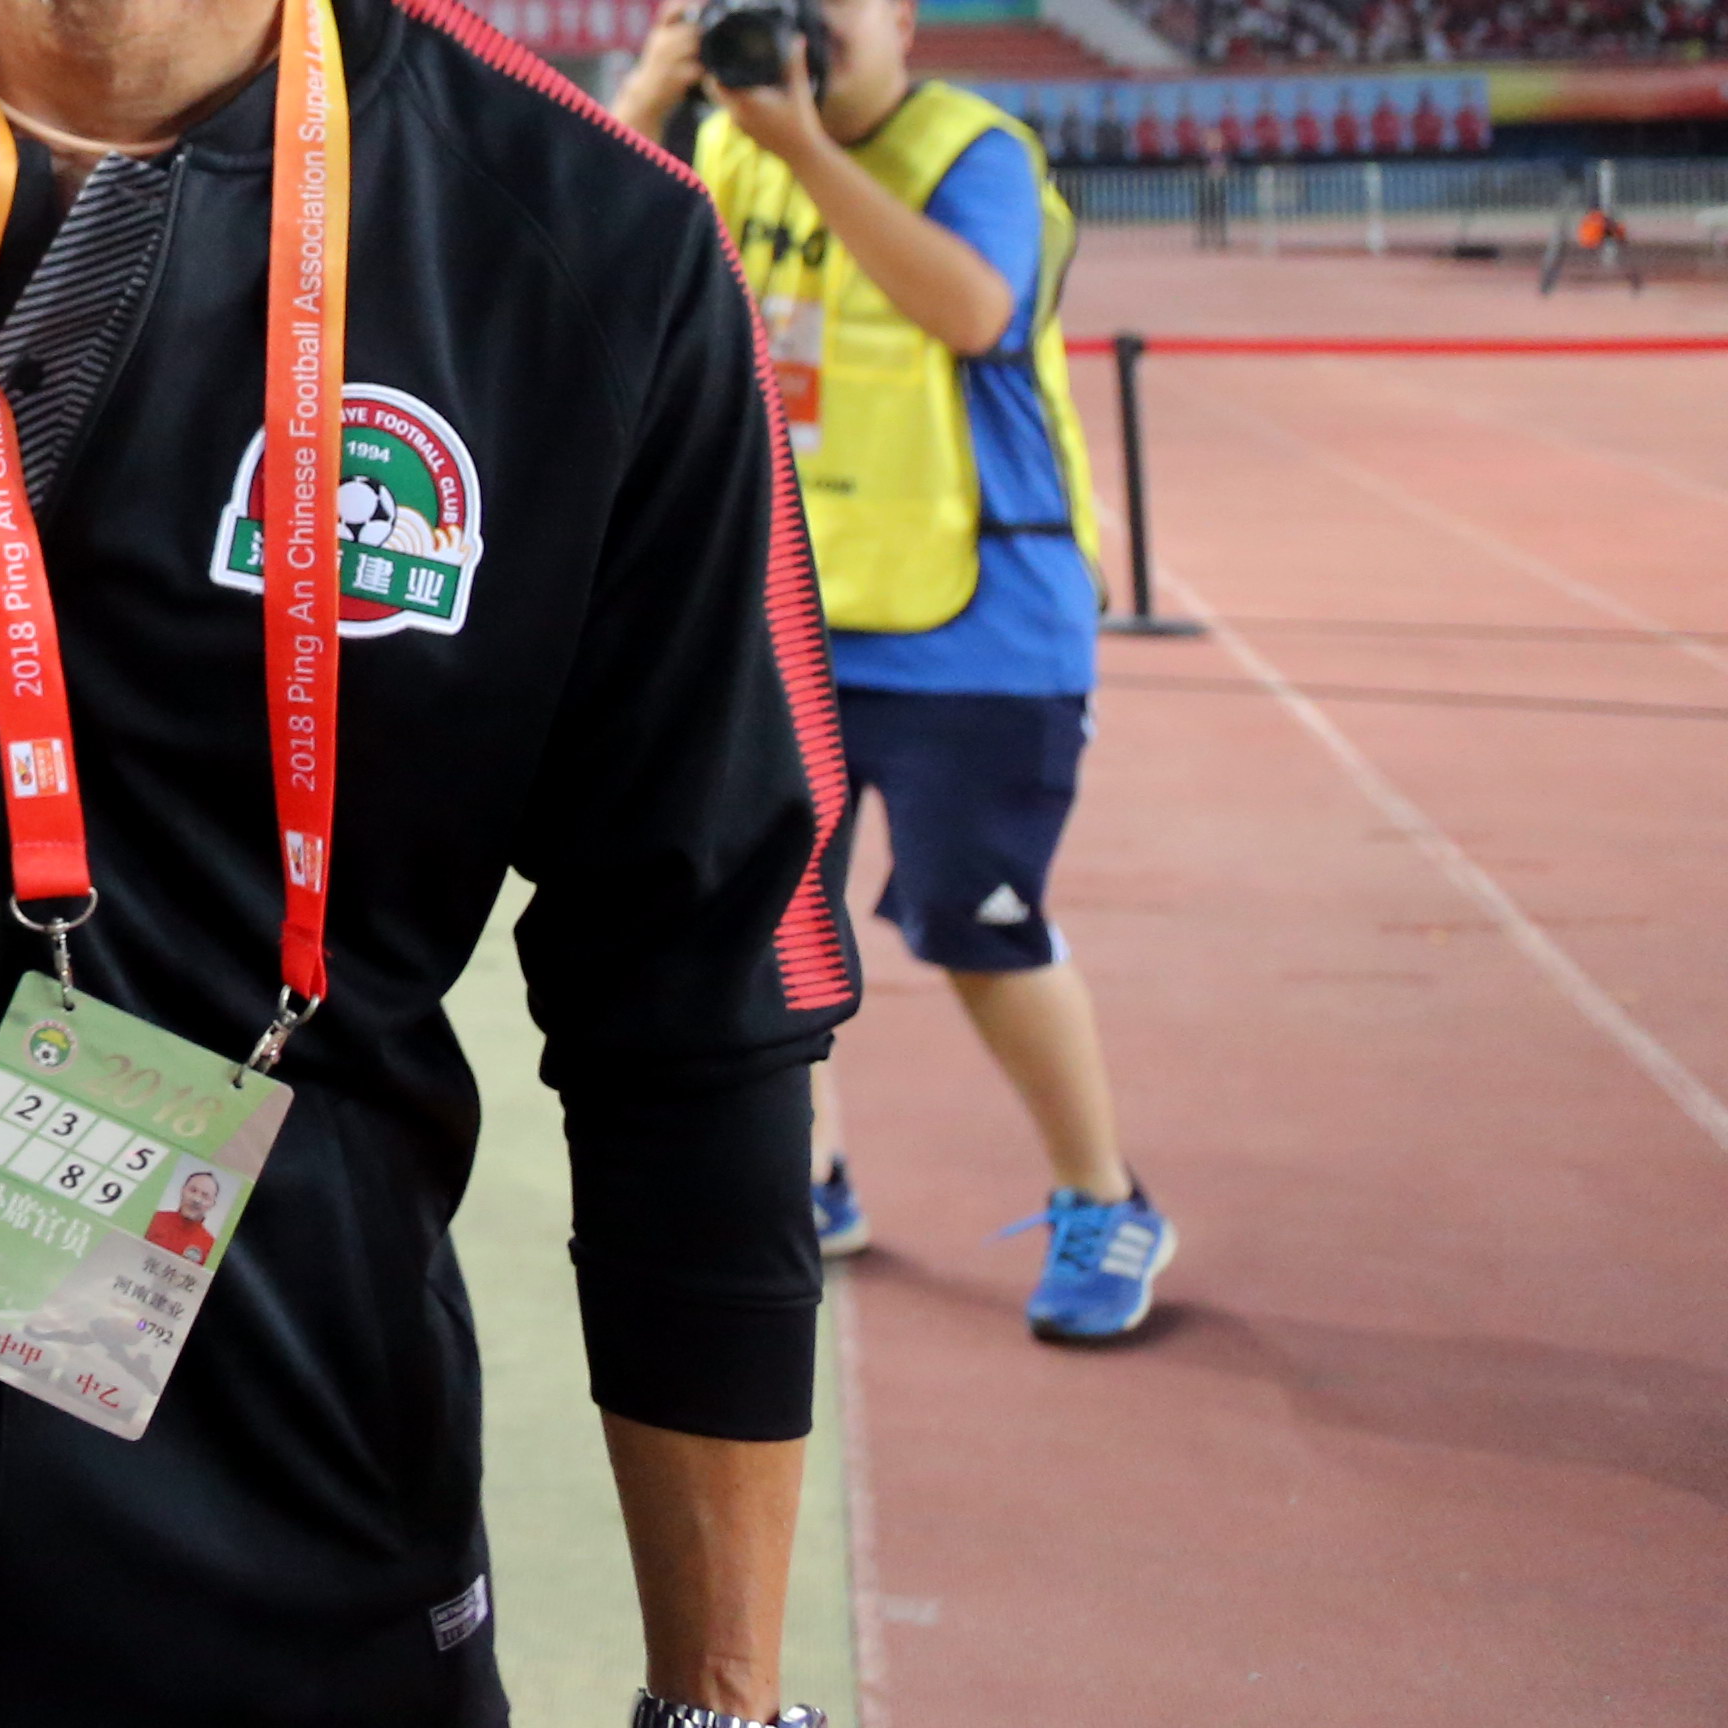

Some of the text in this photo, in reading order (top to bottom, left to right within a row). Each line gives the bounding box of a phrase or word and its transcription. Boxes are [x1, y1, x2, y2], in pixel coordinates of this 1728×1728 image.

[298, 76, 333, 142] Super
[292, 152, 326, 313] Association
[289, 322, 321, 438] Football
[347, 439, 392, 464] 1994
[374, 409, 445, 474] FOOTBALL
[439, 476, 460, 524] CLUB
[287, 446, 317, 570] Chinese
[2, 541, 31, 611] Ping
[287, 580, 316, 624] An
[8, 620, 44, 697] 2018
[287, 635, 324, 704] Ping
[290, 715, 317, 792] 2018
[14, 1095, 156, 1171] 2 3 5
[77, 1053, 224, 1138] 2018
[59, 1164, 123, 1204] 8 9
[76, 1373, 120, 1409] 中乙
